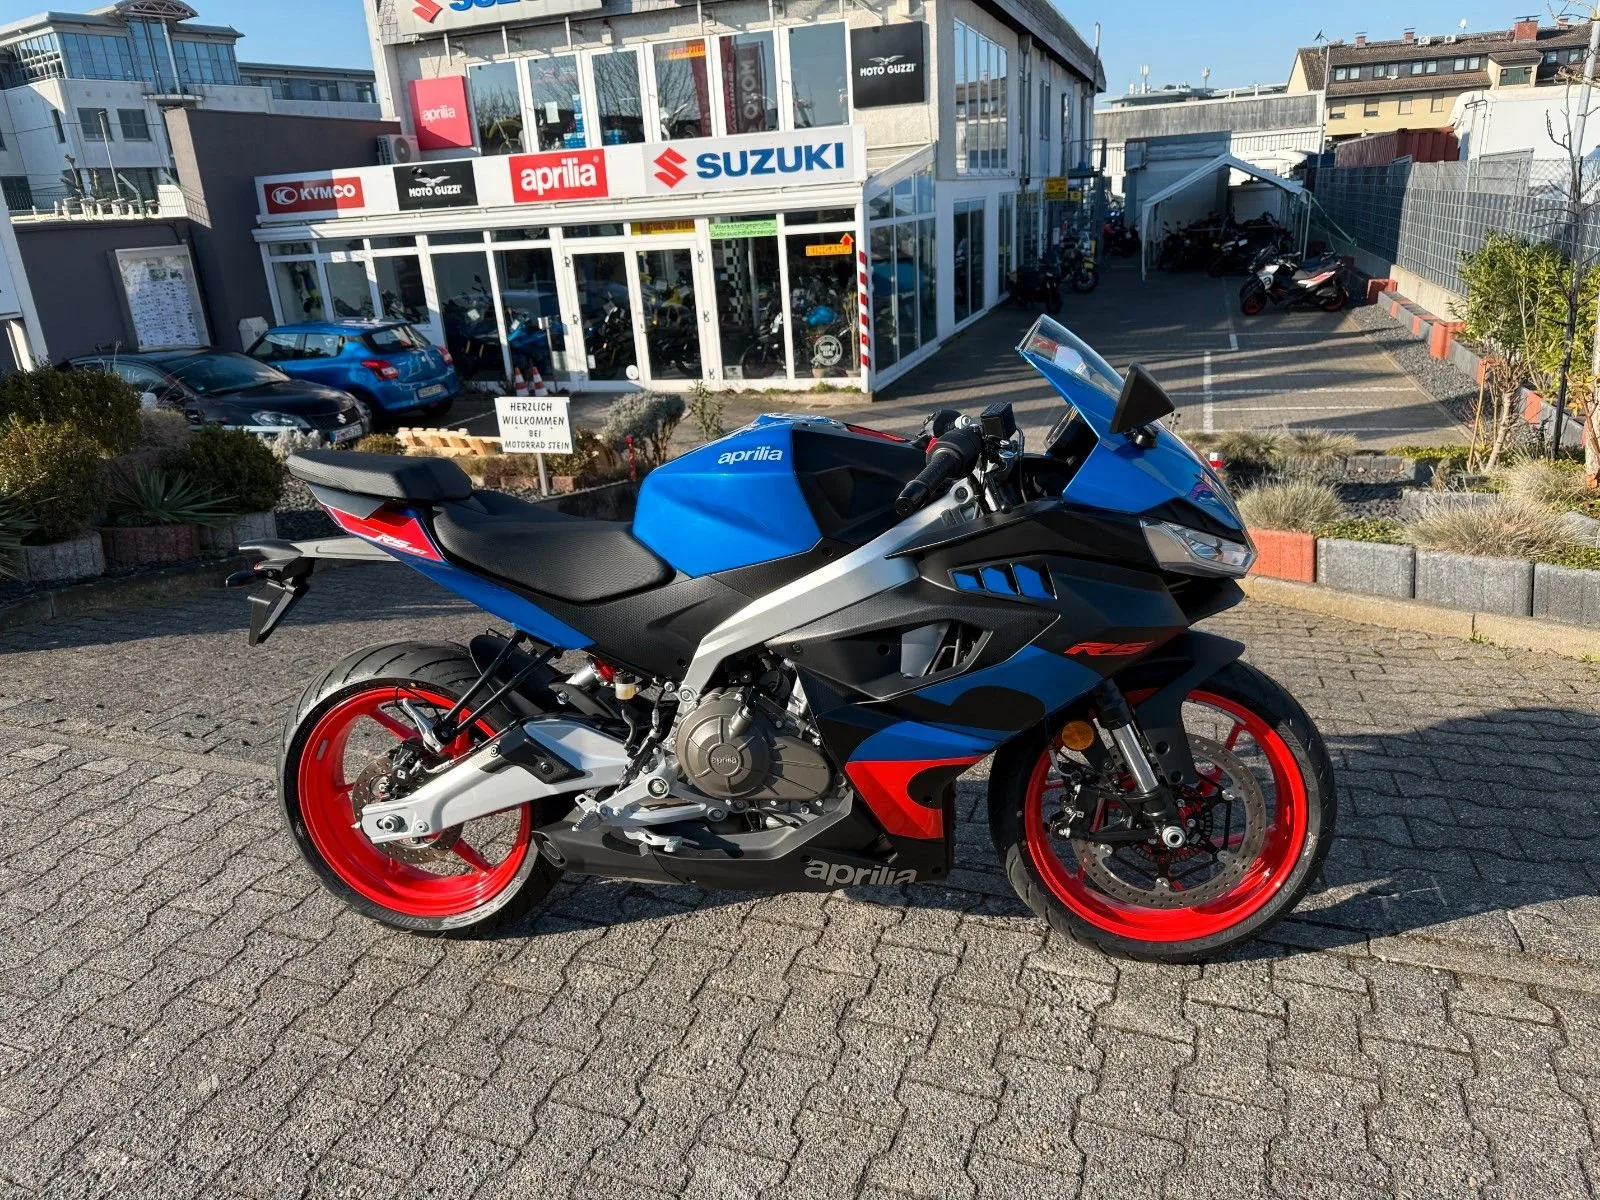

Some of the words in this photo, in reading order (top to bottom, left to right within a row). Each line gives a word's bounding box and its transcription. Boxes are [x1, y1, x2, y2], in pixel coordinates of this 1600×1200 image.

[859, 64, 884, 77] MOTO
[887, 63, 915, 75] GUZZI
[422, 104, 456, 123] aprilia
[696, 142, 845, 180] SUZUKI
[521, 157, 597, 196] aprilia
[300, 184, 356, 200] KYMCO
[408, 186, 432, 198] MOTO
[434, 184, 461, 196] GUZZI
[807, 245, 850, 255] EINGANG
[510, 402, 553, 412] HERZLICH
[502, 416, 565, 426] WILLKOMMEN
[529, 429, 541, 438] BEI
[504, 440, 546, 450] MOTORRAD
[548, 441, 570, 450] STEIN
[717, 446, 783, 465] aprilia
[1064, 641, 1154, 656] RS
[711, 755, 737, 766] aprilia
[804, 859, 918, 886] aprilia
